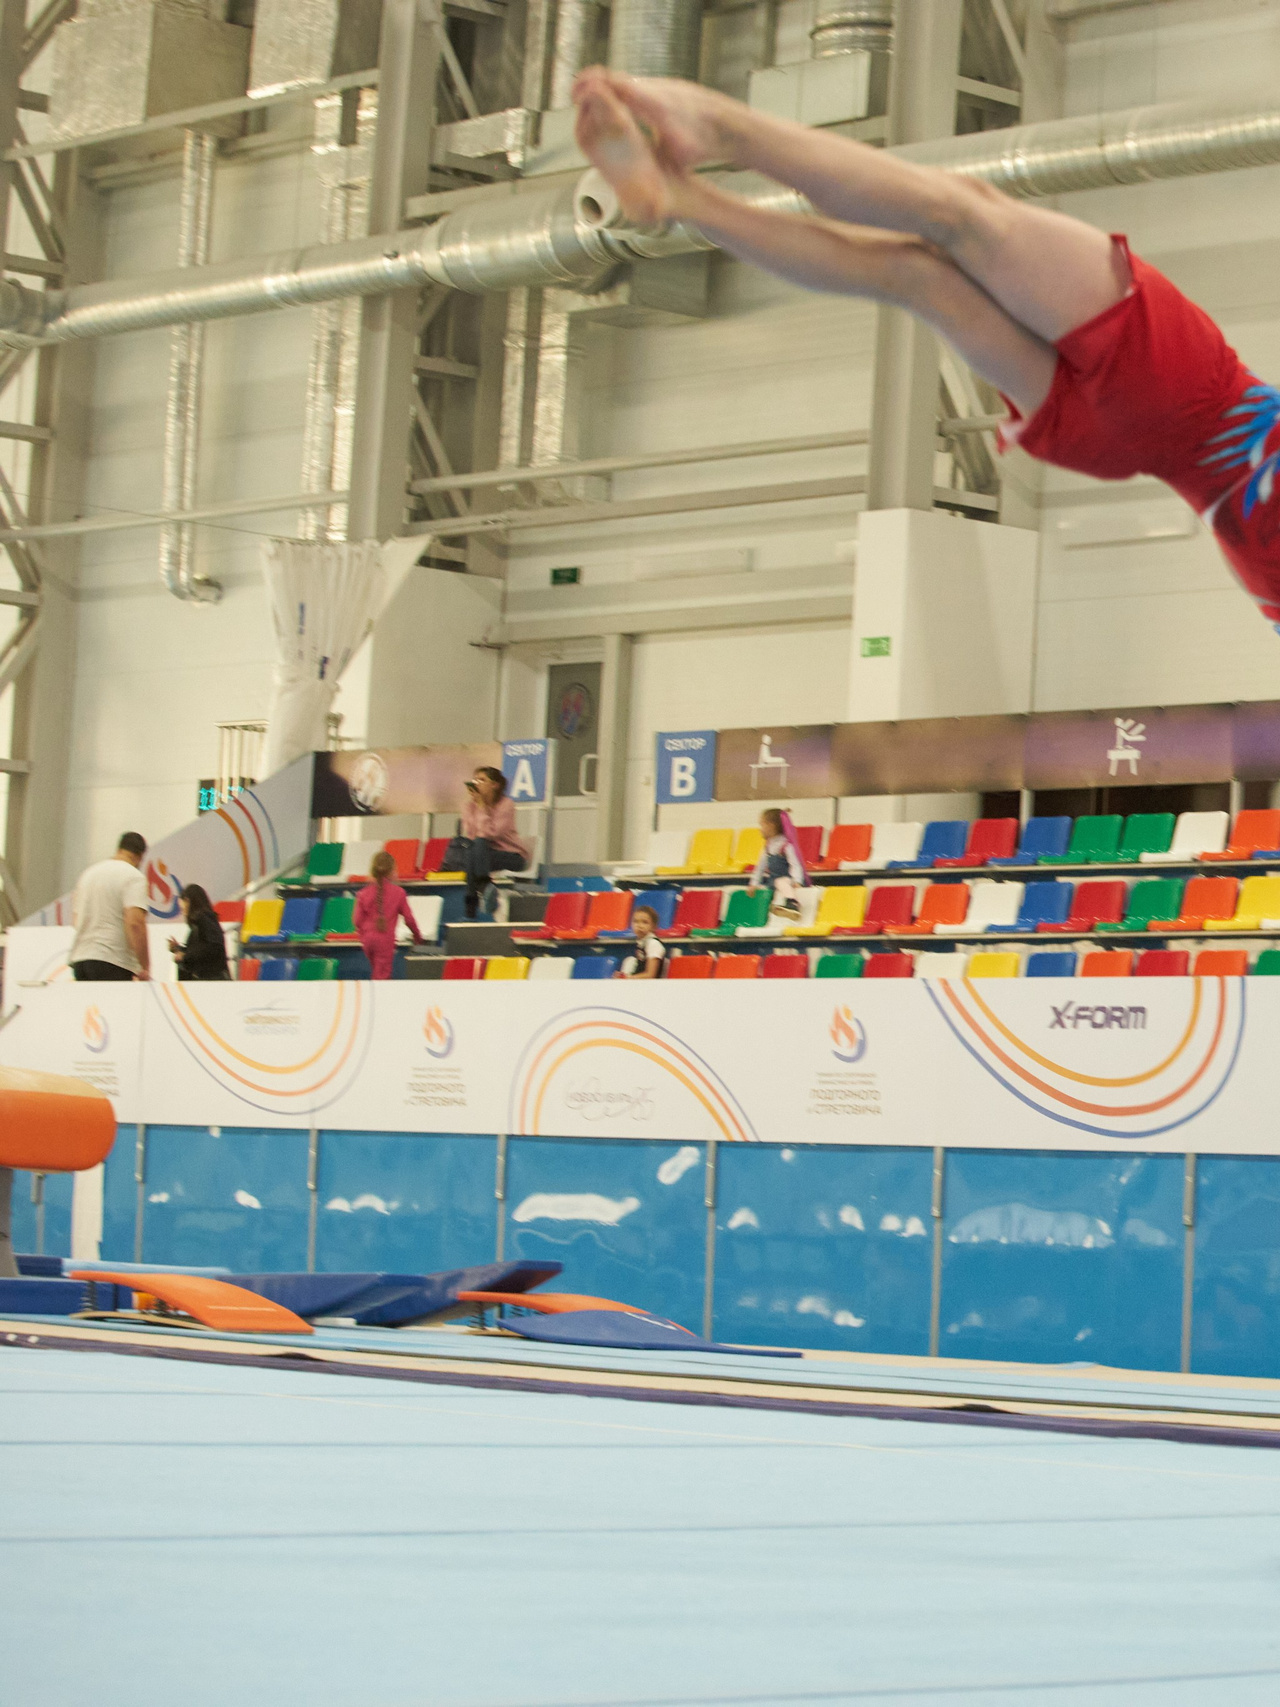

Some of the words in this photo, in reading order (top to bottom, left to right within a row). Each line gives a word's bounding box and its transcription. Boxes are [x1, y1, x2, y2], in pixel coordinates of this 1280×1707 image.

[509, 758, 537, 798] A
[669, 756, 697, 797] B
[1049, 1000, 1148, 1029] X-FORM
